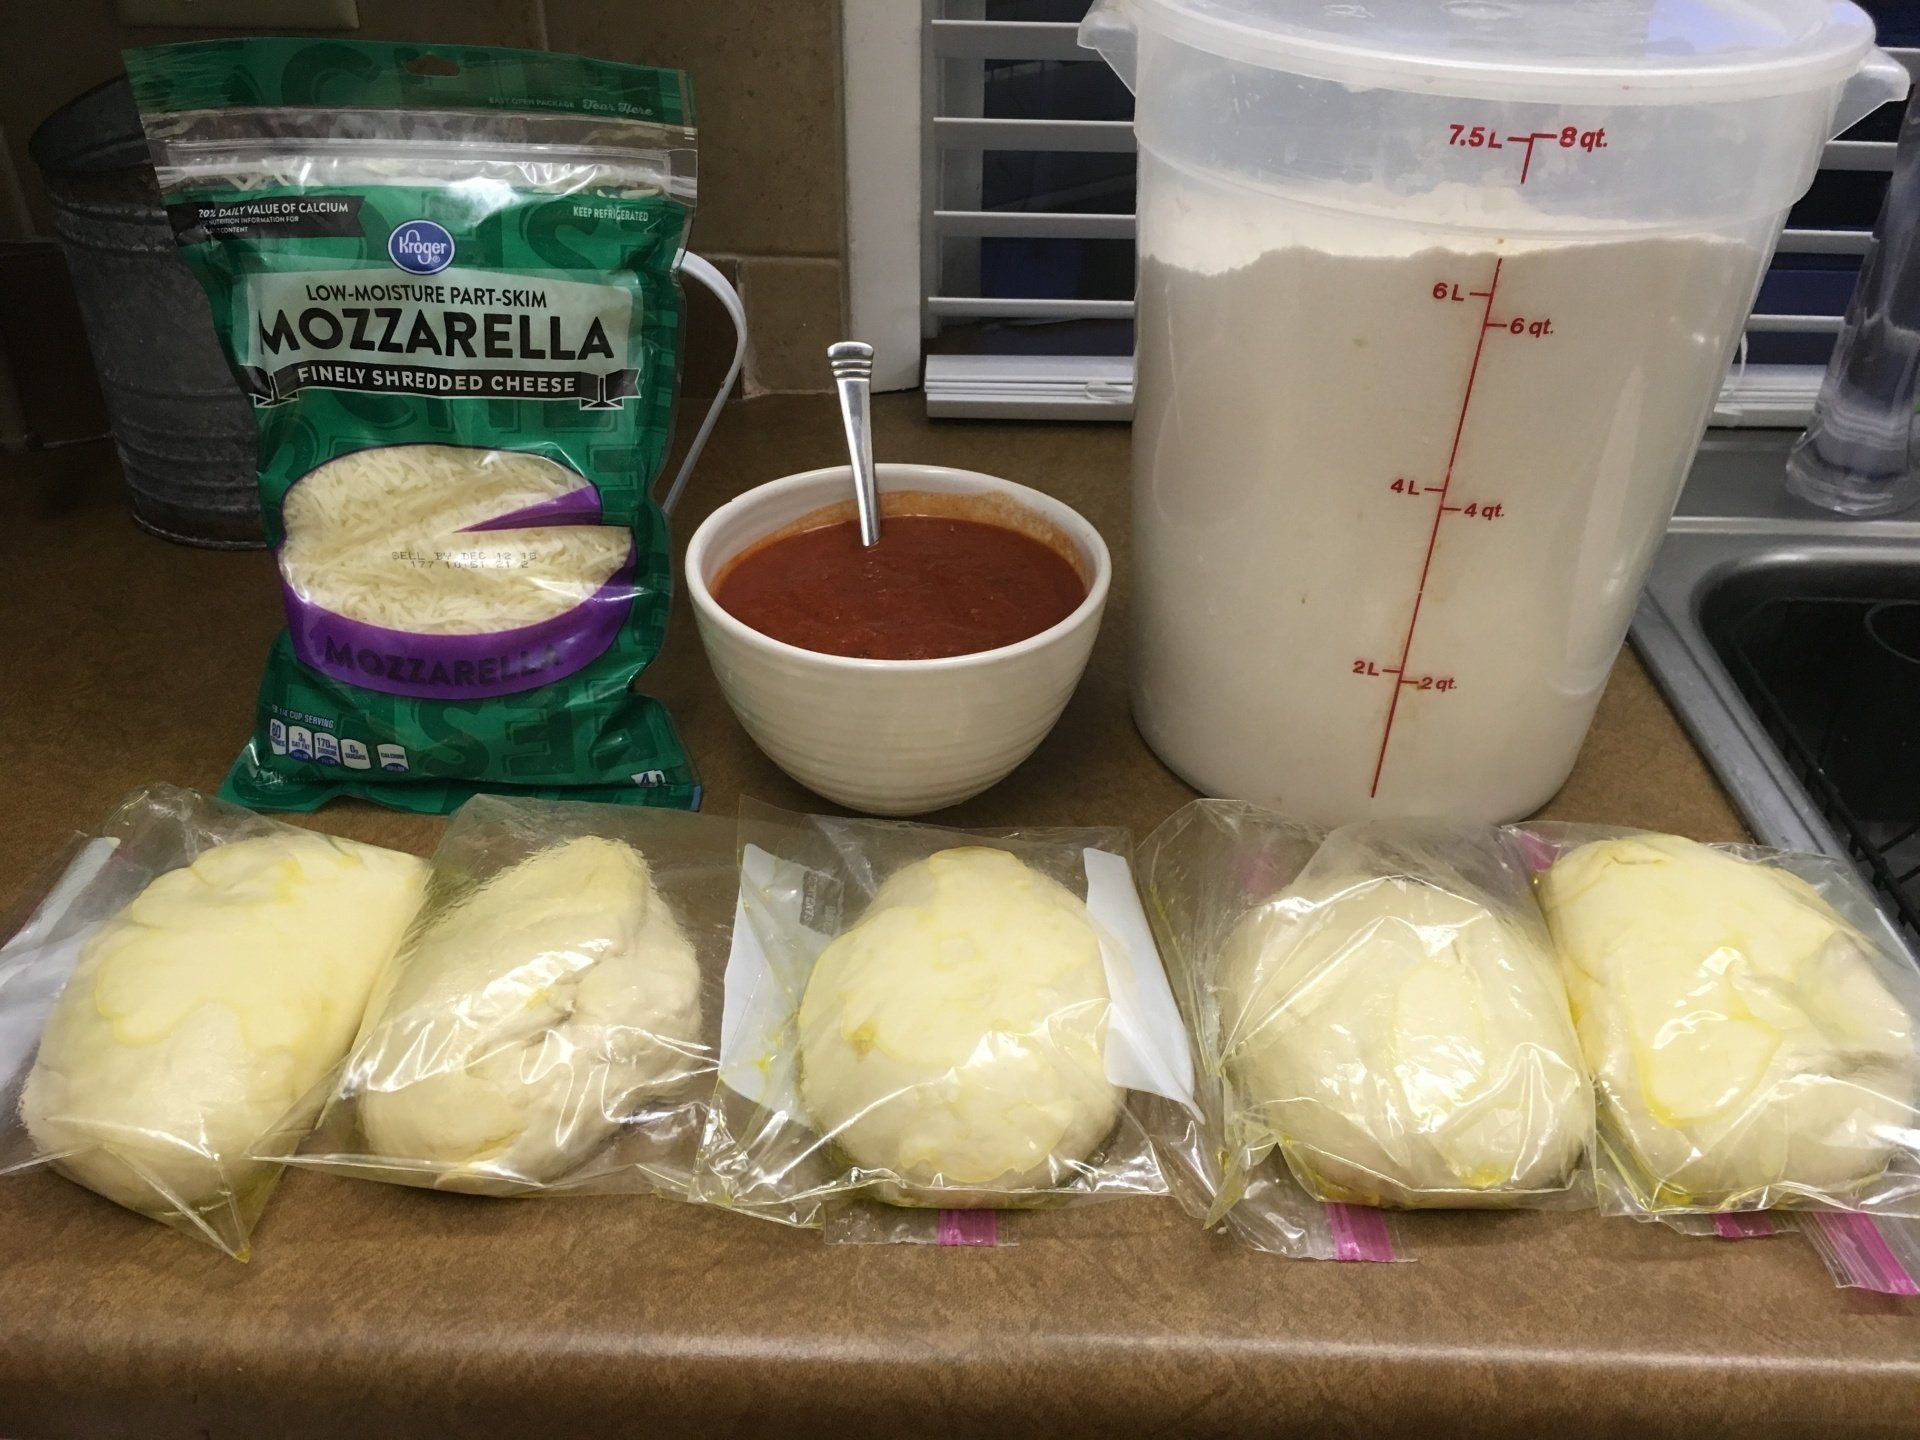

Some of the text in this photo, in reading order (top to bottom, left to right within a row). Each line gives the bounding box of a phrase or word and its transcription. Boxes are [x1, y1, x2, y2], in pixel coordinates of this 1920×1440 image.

[581, 98, 654, 116] Tear Here
[218, 206, 247, 218] DAILY
[247, 203, 280, 215] VALUE
[281, 203, 297, 214] OF
[298, 202, 349, 213] CALCIUM
[573, 206, 649, 222] KEEP REFRIGERATED
[240, 215, 286, 224] INFORMATION
[286, 215, 300, 223] FOR
[398, 229, 447, 265] Kroger
[305, 284, 547, 308] LOW-MOISTURE PART-SKIM
[258, 307, 615, 361] MOZZARELLA
[297, 365, 576, 393] FINELY SHREDDED CHEESE
[391, 551, 425, 561] SELL
[462, 551, 487, 560] DEC
[496, 551, 512, 560] 12
[411, 560, 435, 569] 177
[289, 710, 303, 721] CUP
[304, 714, 335, 729] SERVING
